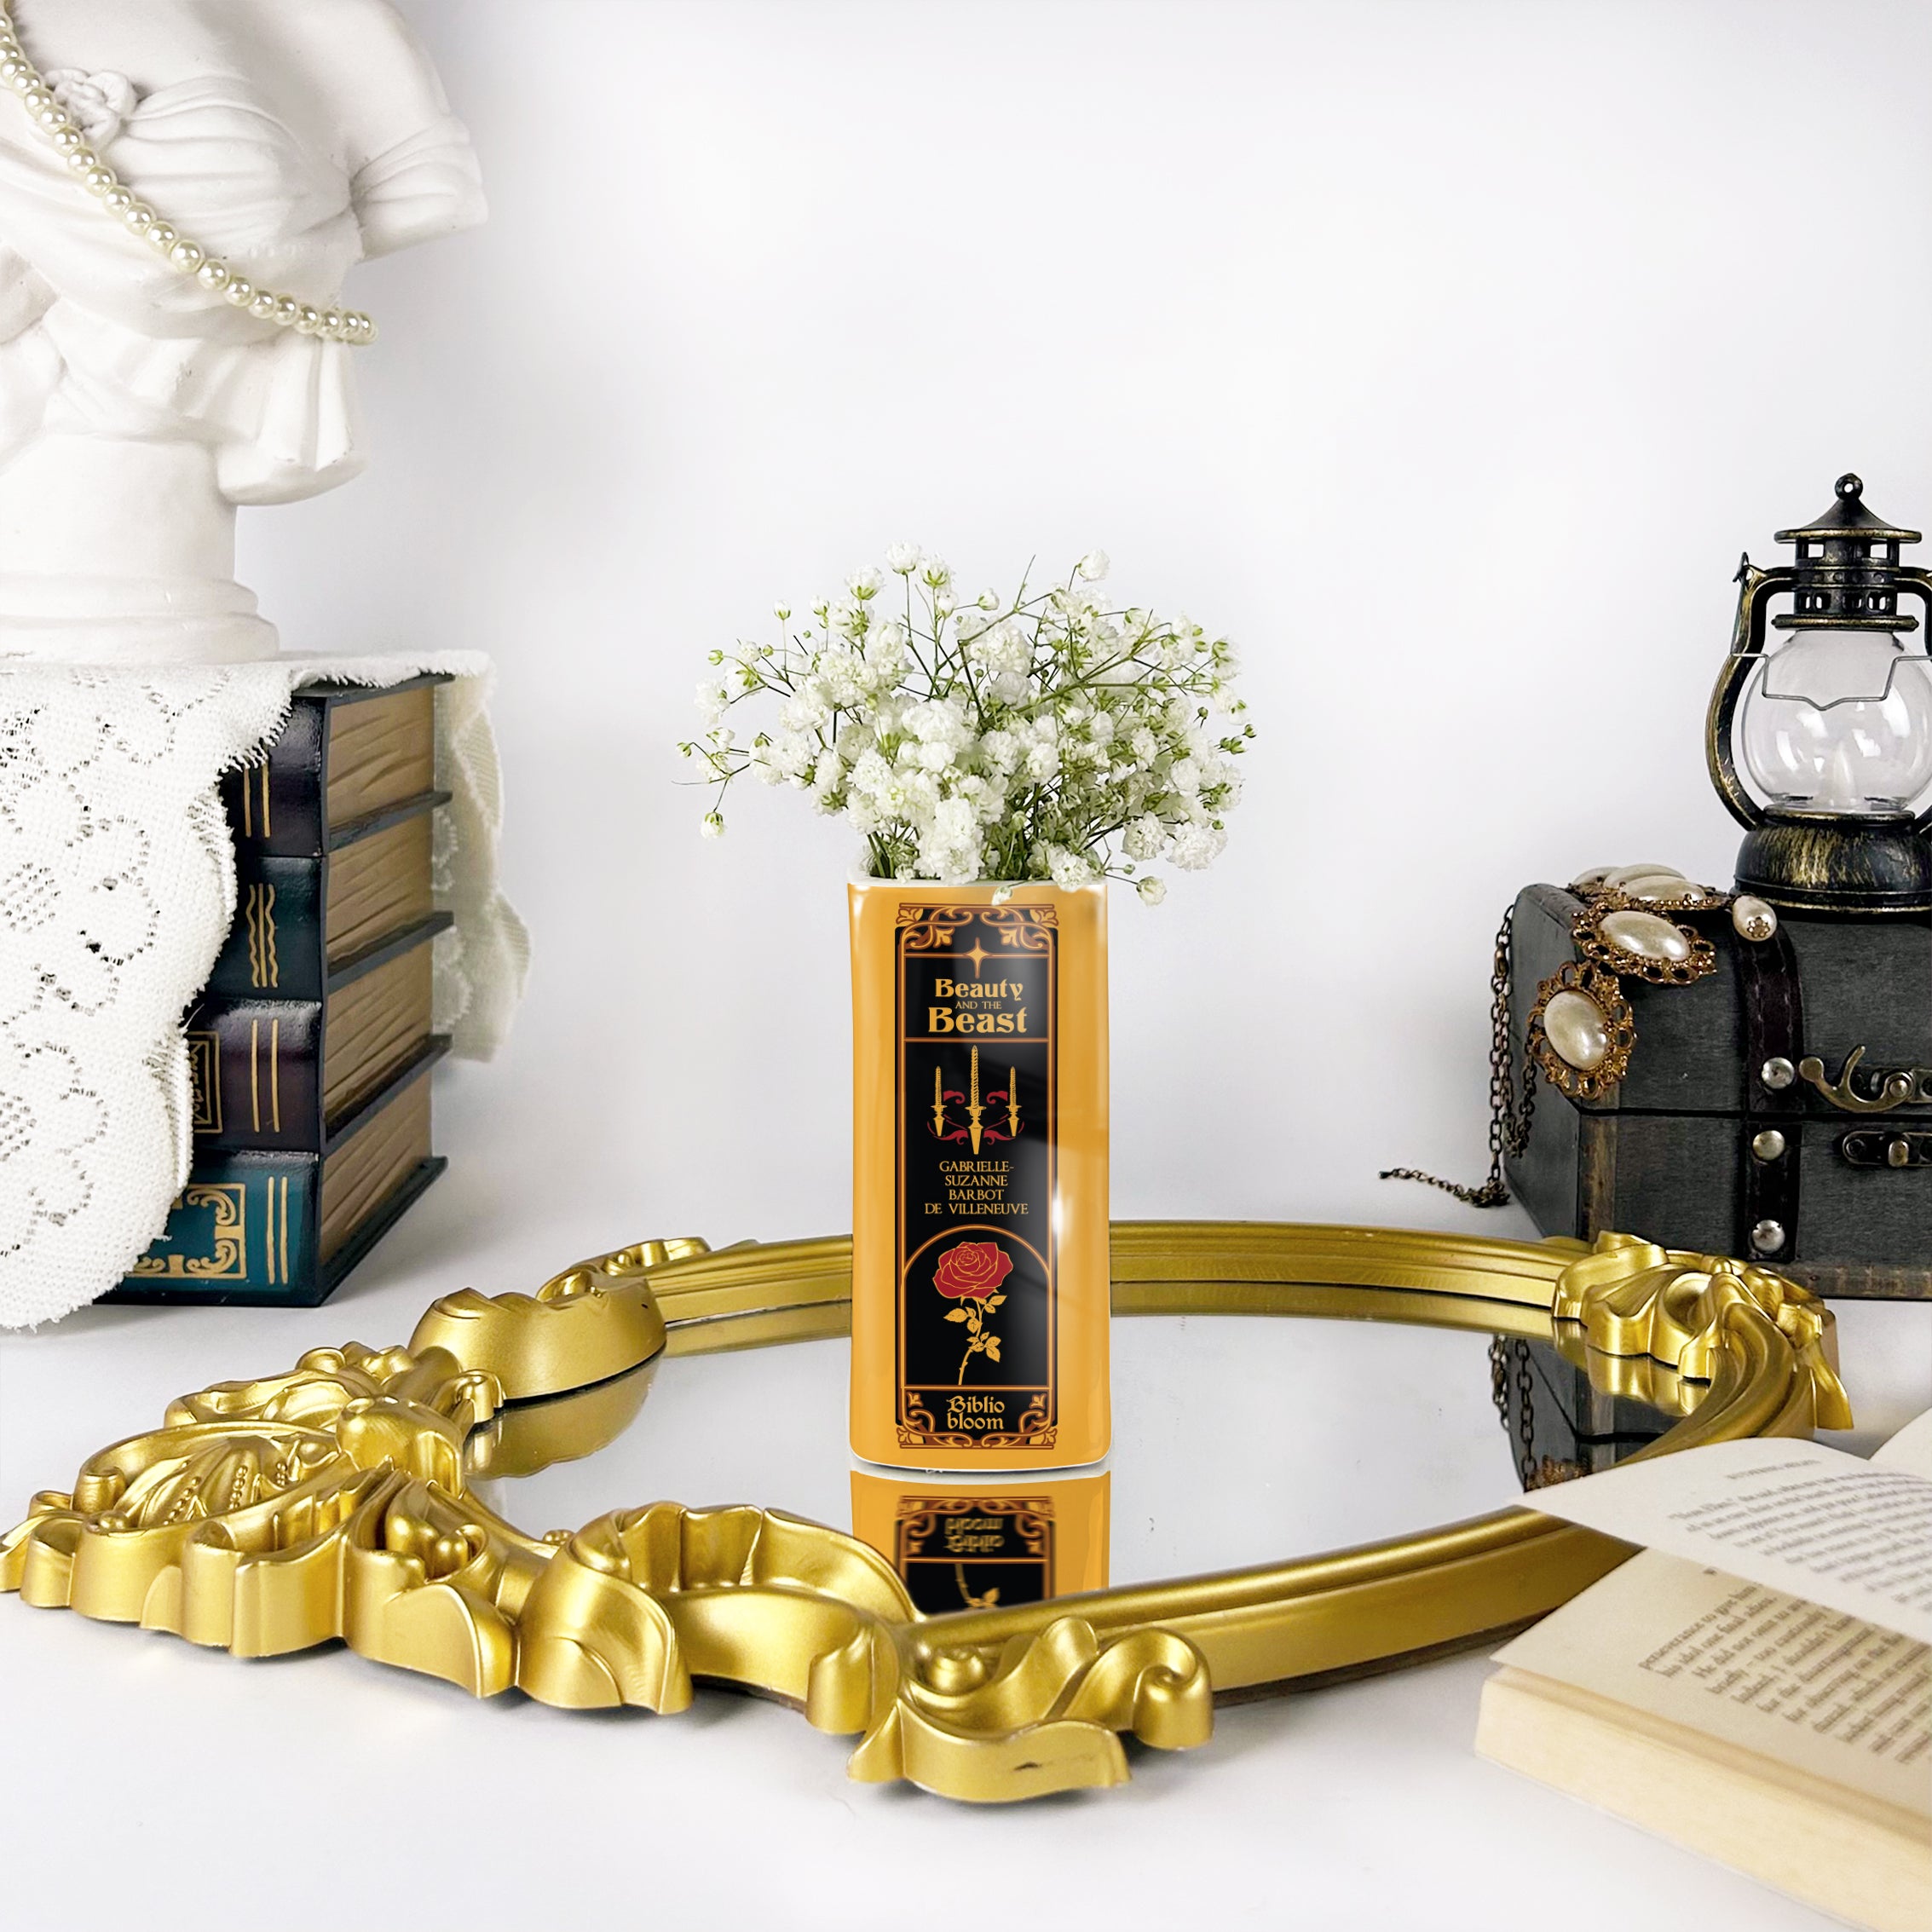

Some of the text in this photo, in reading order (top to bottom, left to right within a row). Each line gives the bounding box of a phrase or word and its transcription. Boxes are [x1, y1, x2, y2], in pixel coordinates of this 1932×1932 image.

[935, 978, 1024, 1001] Beauty
[955, 1001, 1002, 1010] AND THE
[928, 1006, 1028, 1034] Beast
[939, 1161, 1014, 1173] GABRIELLE-
[944, 1174, 1008, 1187] SUZANNE
[949, 1188, 1005, 1201] BARBOT
[925, 1202, 1029, 1215] DE VILLENEUVE
[946, 1395, 1006, 1414] Biblio
[946, 1411, 1005, 1431] bloom
